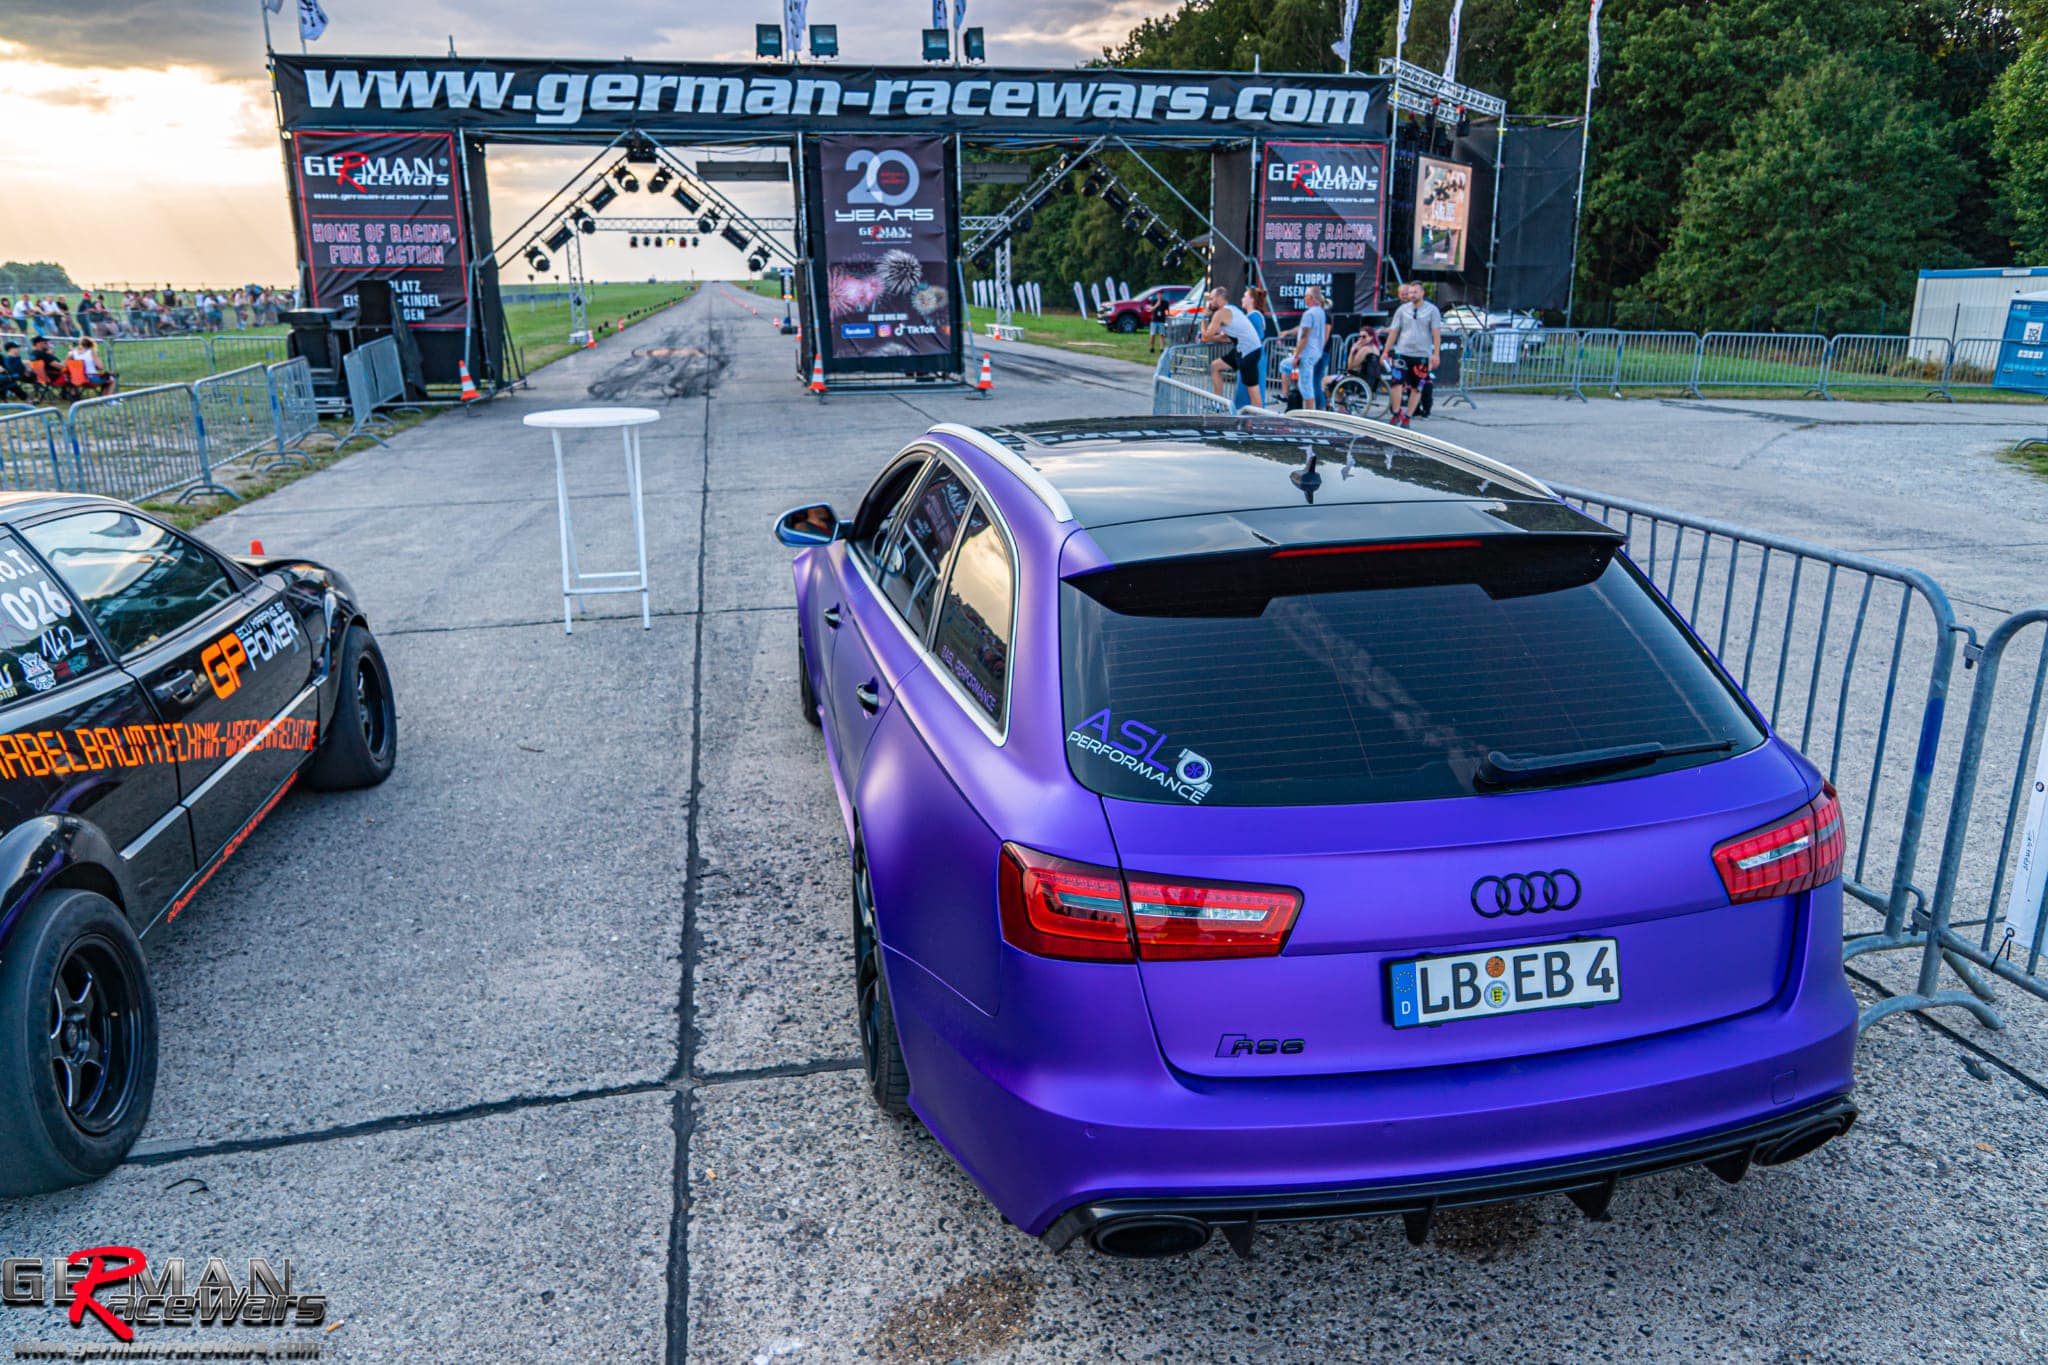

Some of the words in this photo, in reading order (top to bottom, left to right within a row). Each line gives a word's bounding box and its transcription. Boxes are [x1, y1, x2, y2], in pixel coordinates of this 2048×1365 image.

[304, 69, 1371, 125] www.german-racewars.com
[303, 152, 435, 180] GERMAN
[1268, 160, 1367, 183] GERMAN
[845, 149, 920, 206] 20
[835, 208, 934, 222] YEARS
[312, 223, 361, 243] HOME
[364, 223, 385, 243] OF
[389, 223, 456, 245] RACING,
[1265, 222, 1302, 240] HOME
[1305, 223, 1322, 241] OF
[1325, 223, 1376, 242] RACING,
[329, 245, 363, 265] FUN
[366, 245, 380, 264] &
[385, 245, 445, 265] ACTION
[1275, 242, 1301, 259] FUN
[1304, 242, 1314, 259] &
[1317, 242, 1366, 259] ACTION
[1295, 273, 1332, 285] FLUGPLA
[907, 325, 937, 335] TikTok
[1, 580, 71, 630] 026
[201, 631, 247, 700] GP
[242, 611, 299, 672] POWER
[1073, 708, 1170, 773] ASL
[1066, 731, 1208, 804] PERFORMANCE
[1420, 961, 1482, 1014] LB
[1513, 951, 1574, 1002] EB
[1586, 946, 1615, 993] 4
[1401, 1000, 1411, 1015] D
[1230, 1038, 1306, 1055] RS6
